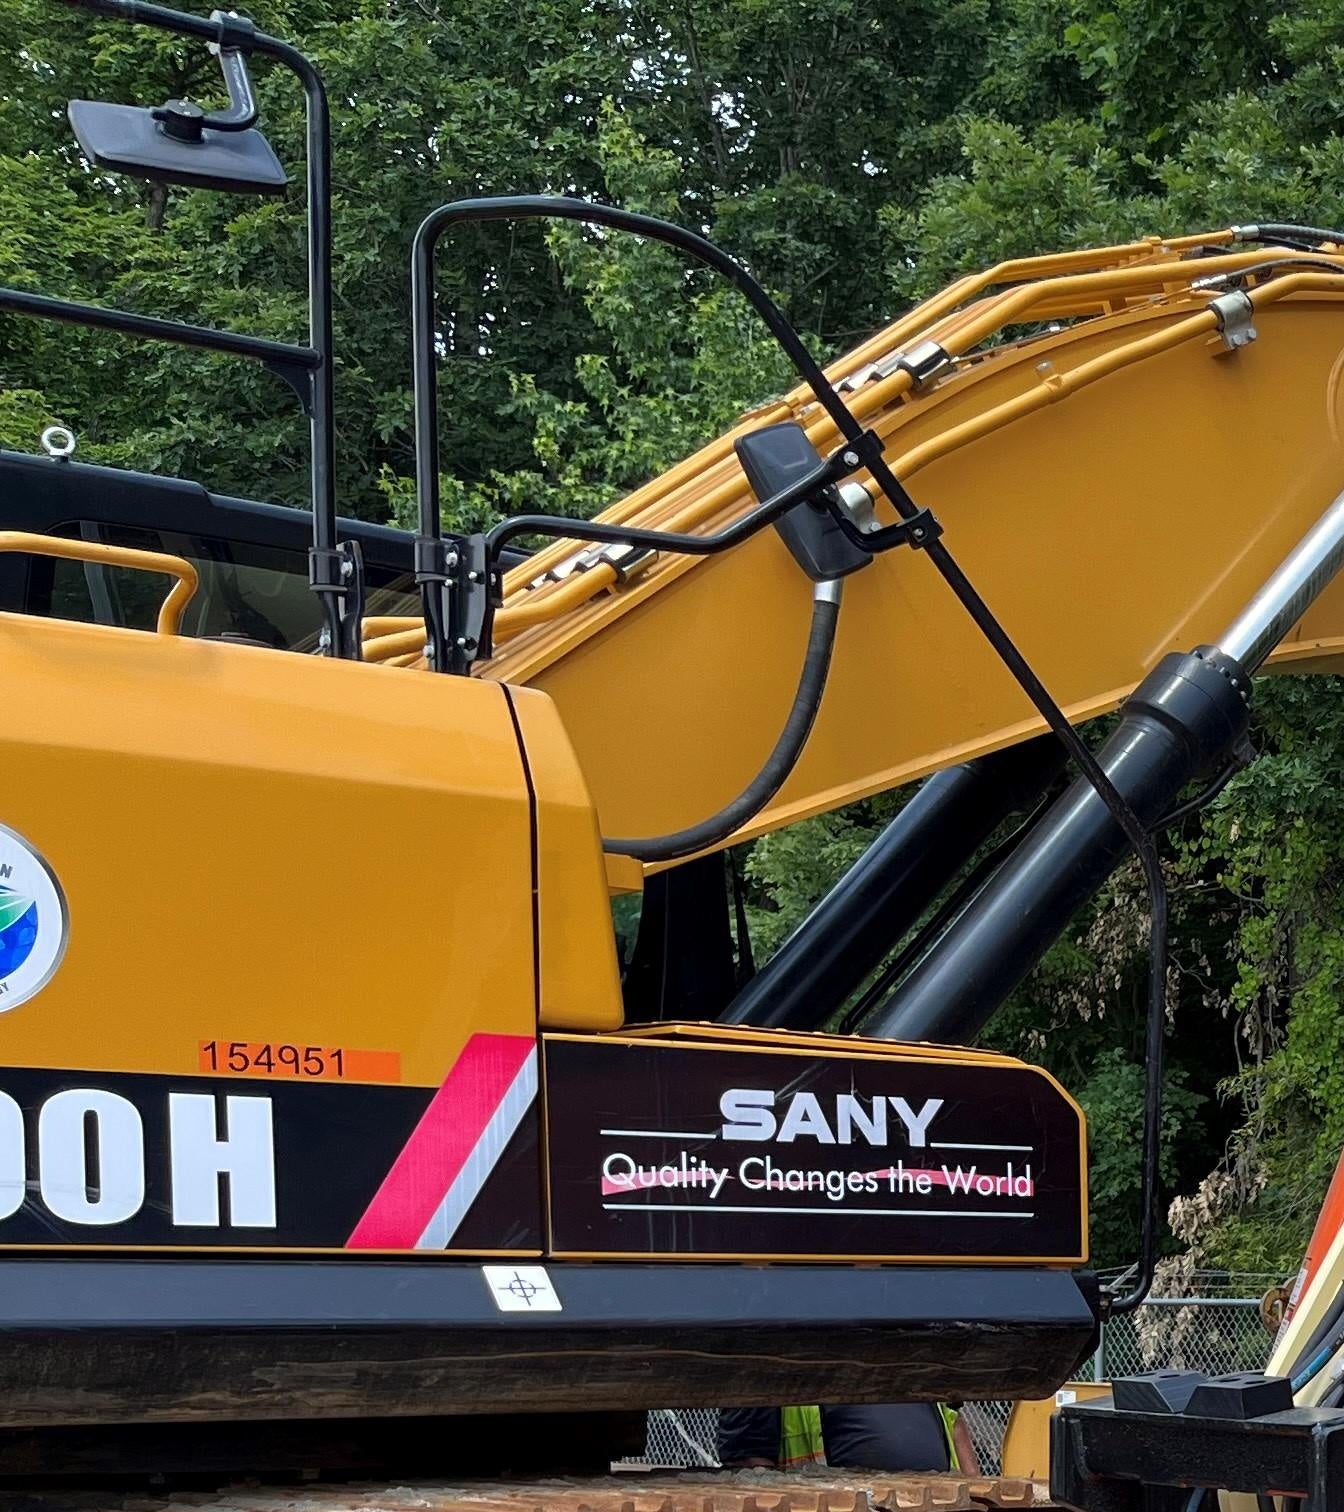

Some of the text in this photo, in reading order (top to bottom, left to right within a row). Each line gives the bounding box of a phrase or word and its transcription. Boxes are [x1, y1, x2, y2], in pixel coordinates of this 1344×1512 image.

[203, 1041, 345, 1077] 154951
[719, 1088, 945, 1147] SANY
[0, 1088, 277, 1228] 0H
[602, 1151, 1033, 1200] Quality Changes the World
